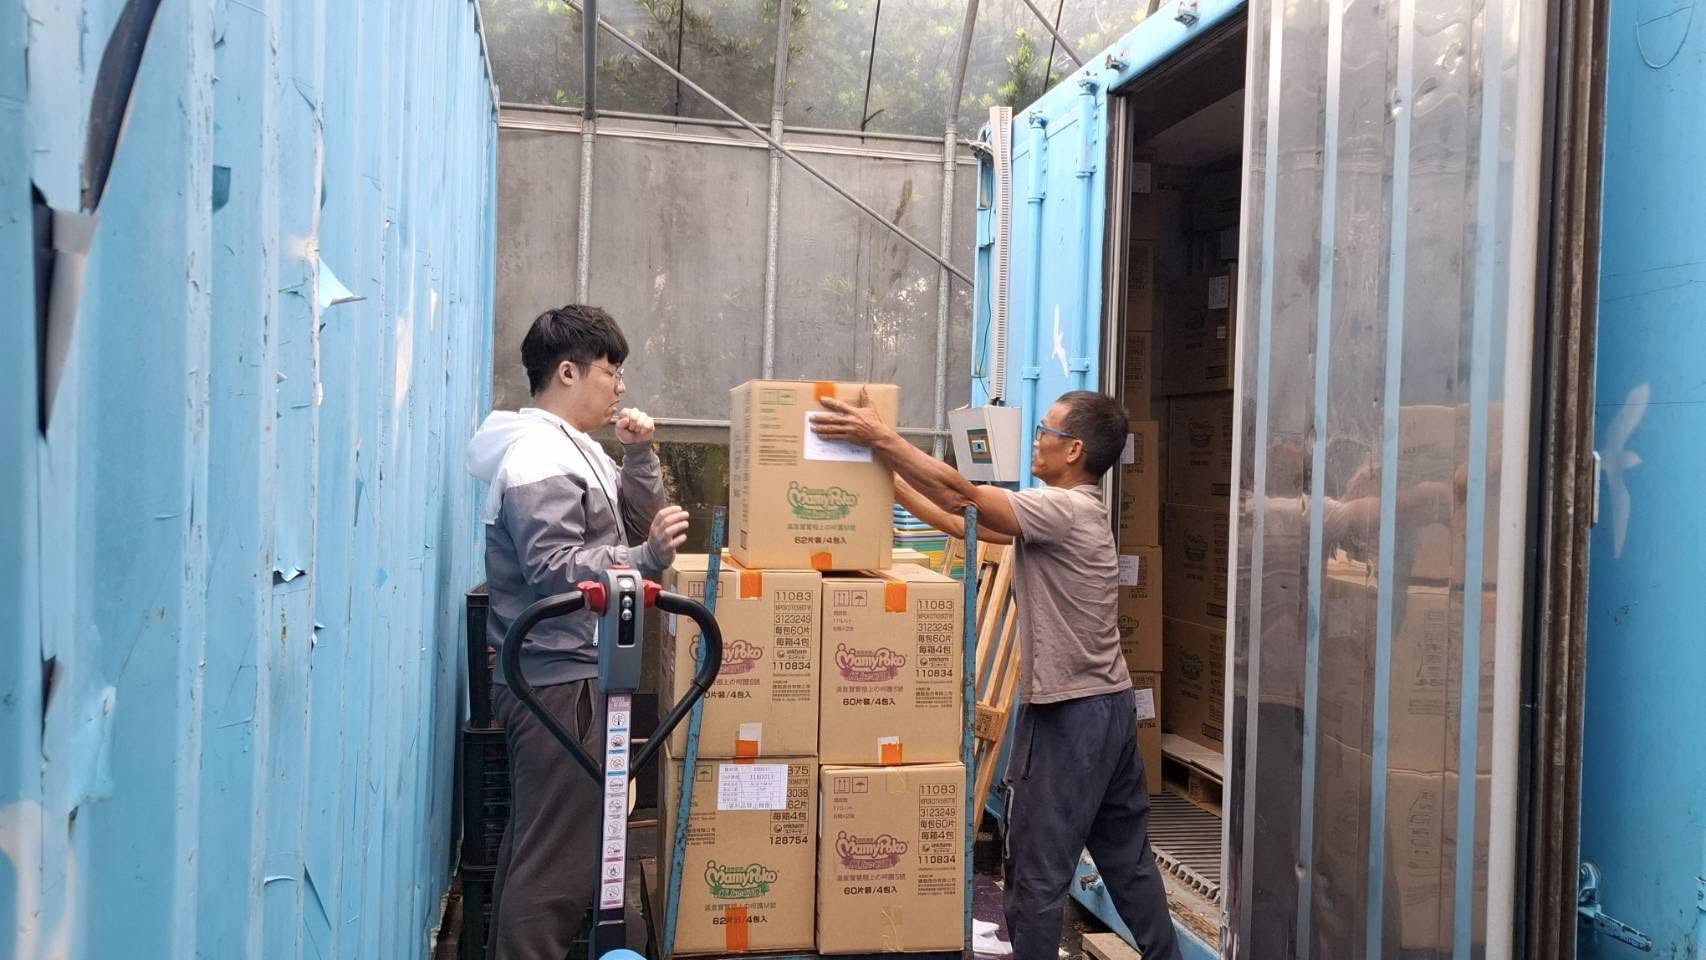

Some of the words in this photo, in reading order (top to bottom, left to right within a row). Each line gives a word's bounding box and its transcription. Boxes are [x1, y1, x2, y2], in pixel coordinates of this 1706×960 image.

[787, 480, 859, 510] MamyPoko
[775, 591, 812, 601] 11083
[918, 600, 953, 610] 11083
[775, 614, 811, 624] 3123249
[775, 626, 811, 635] 每包60片
[918, 622, 953, 632] 3123249
[776, 637, 810, 647] 每箱4包
[918, 634, 951, 643] 每包60片
[919, 645, 951, 654] 每箱4包
[835, 643, 906, 671] MamyPoko
[772, 662, 811, 671] 110834
[916, 669, 953, 678] 110834
[704, 691, 752, 699] 0片裝/4包入
[920, 785, 956, 794] 11083
[773, 811, 807, 820] 每箱4包
[920, 808, 956, 817] 3123249
[920, 820, 954, 828] 每包60片
[921, 831, 954, 840] 每箱4包
[769, 836, 809, 845] 128754
[835, 831, 908, 858] MamyPoko
[918, 856, 956, 864] 110834
[704, 860, 778, 888] MamyPoko
